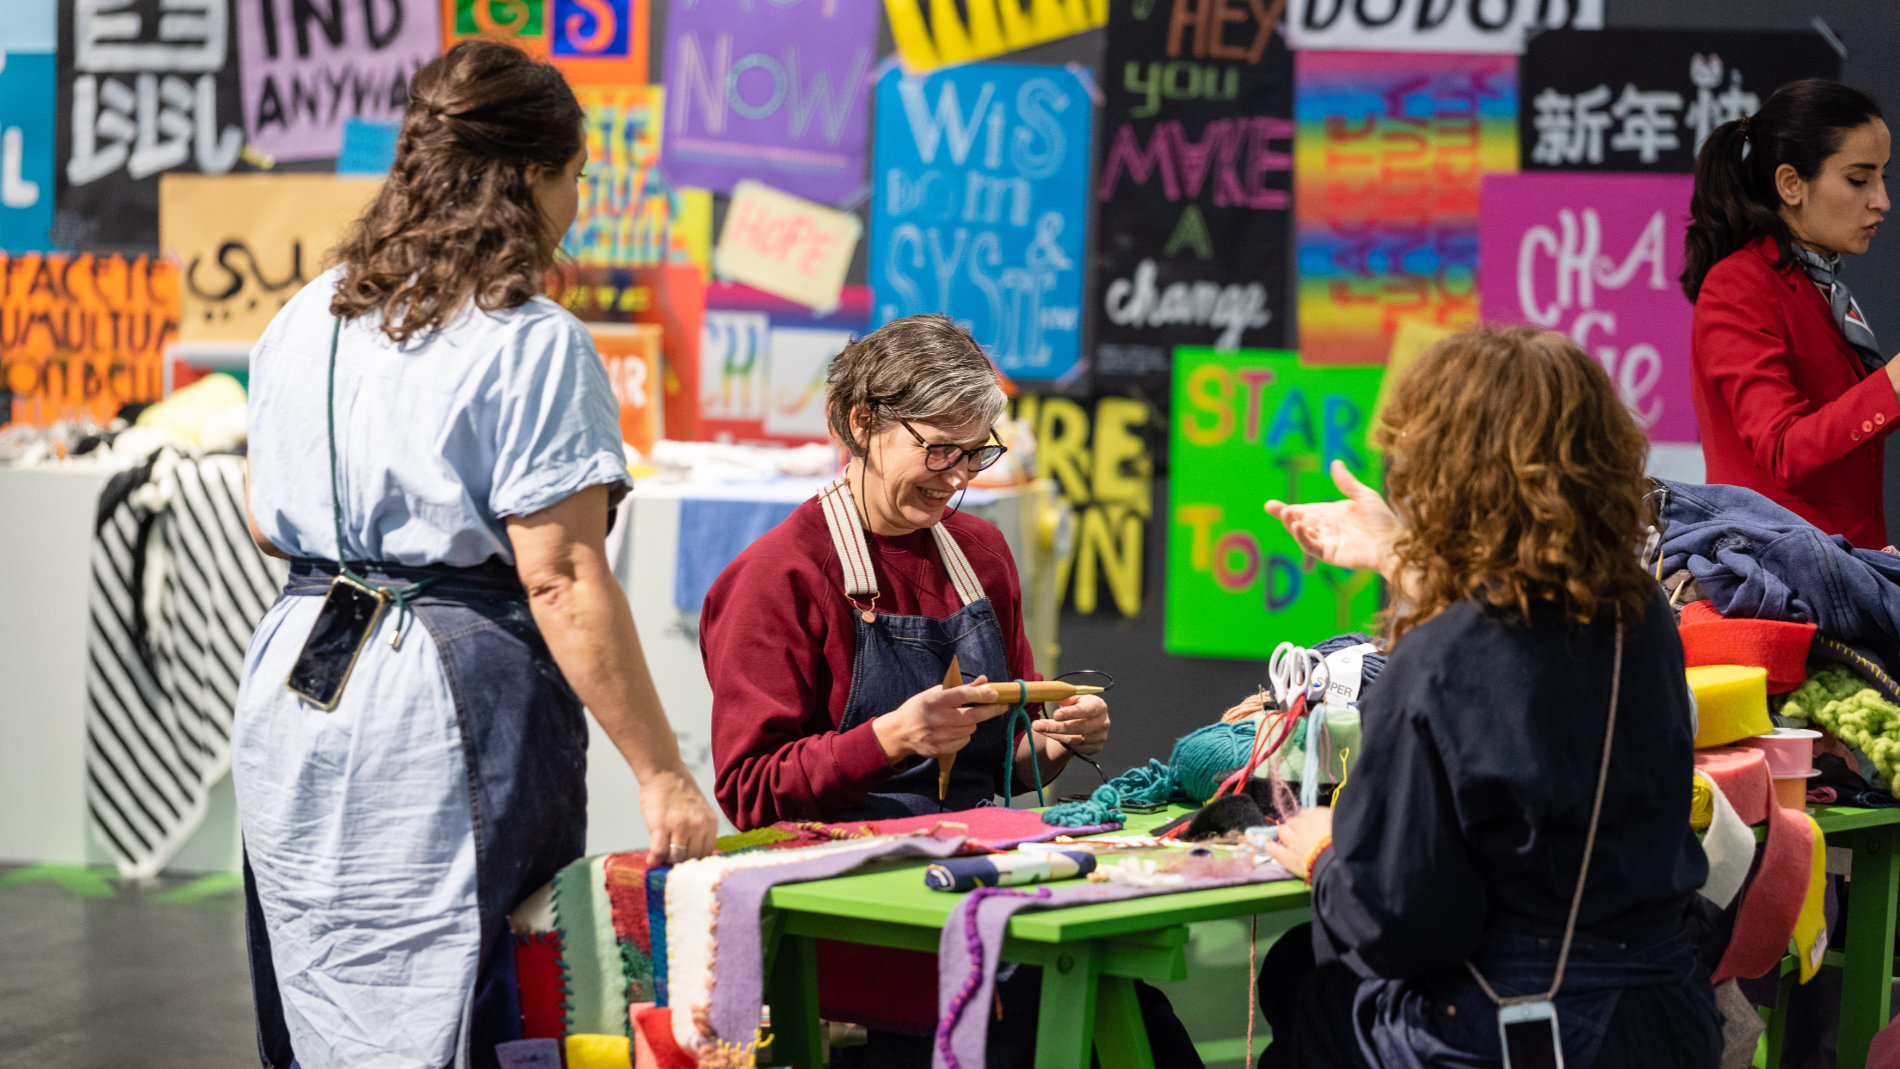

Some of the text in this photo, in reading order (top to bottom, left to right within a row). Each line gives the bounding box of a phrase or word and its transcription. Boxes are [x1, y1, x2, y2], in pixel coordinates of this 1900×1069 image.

[257, 57, 421, 131] ANYWA
[1098, 116, 1295, 211] MAKE
[1163, 203, 1215, 260] A
[1104, 257, 1273, 354] change
[1177, 503, 1375, 630] TODY
